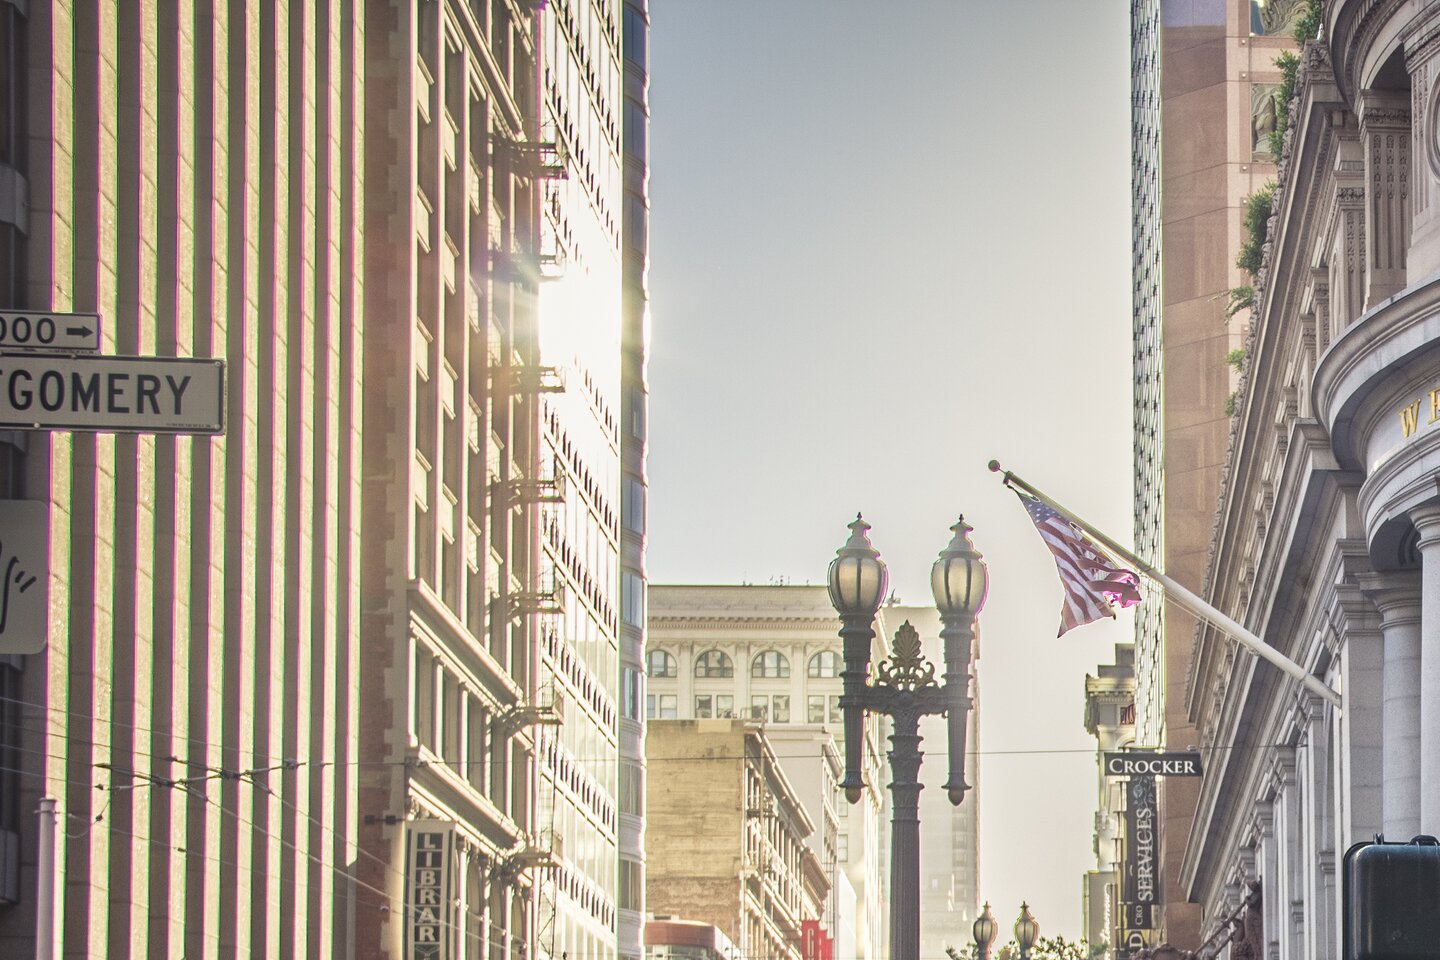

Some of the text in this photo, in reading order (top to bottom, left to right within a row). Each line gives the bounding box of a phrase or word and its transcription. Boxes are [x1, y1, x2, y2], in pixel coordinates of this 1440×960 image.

[0, 369, 192, 415] GOMERY
[1109, 758, 1196, 774] CROCKER
[1136, 807, 1153, 902] SERVICES
